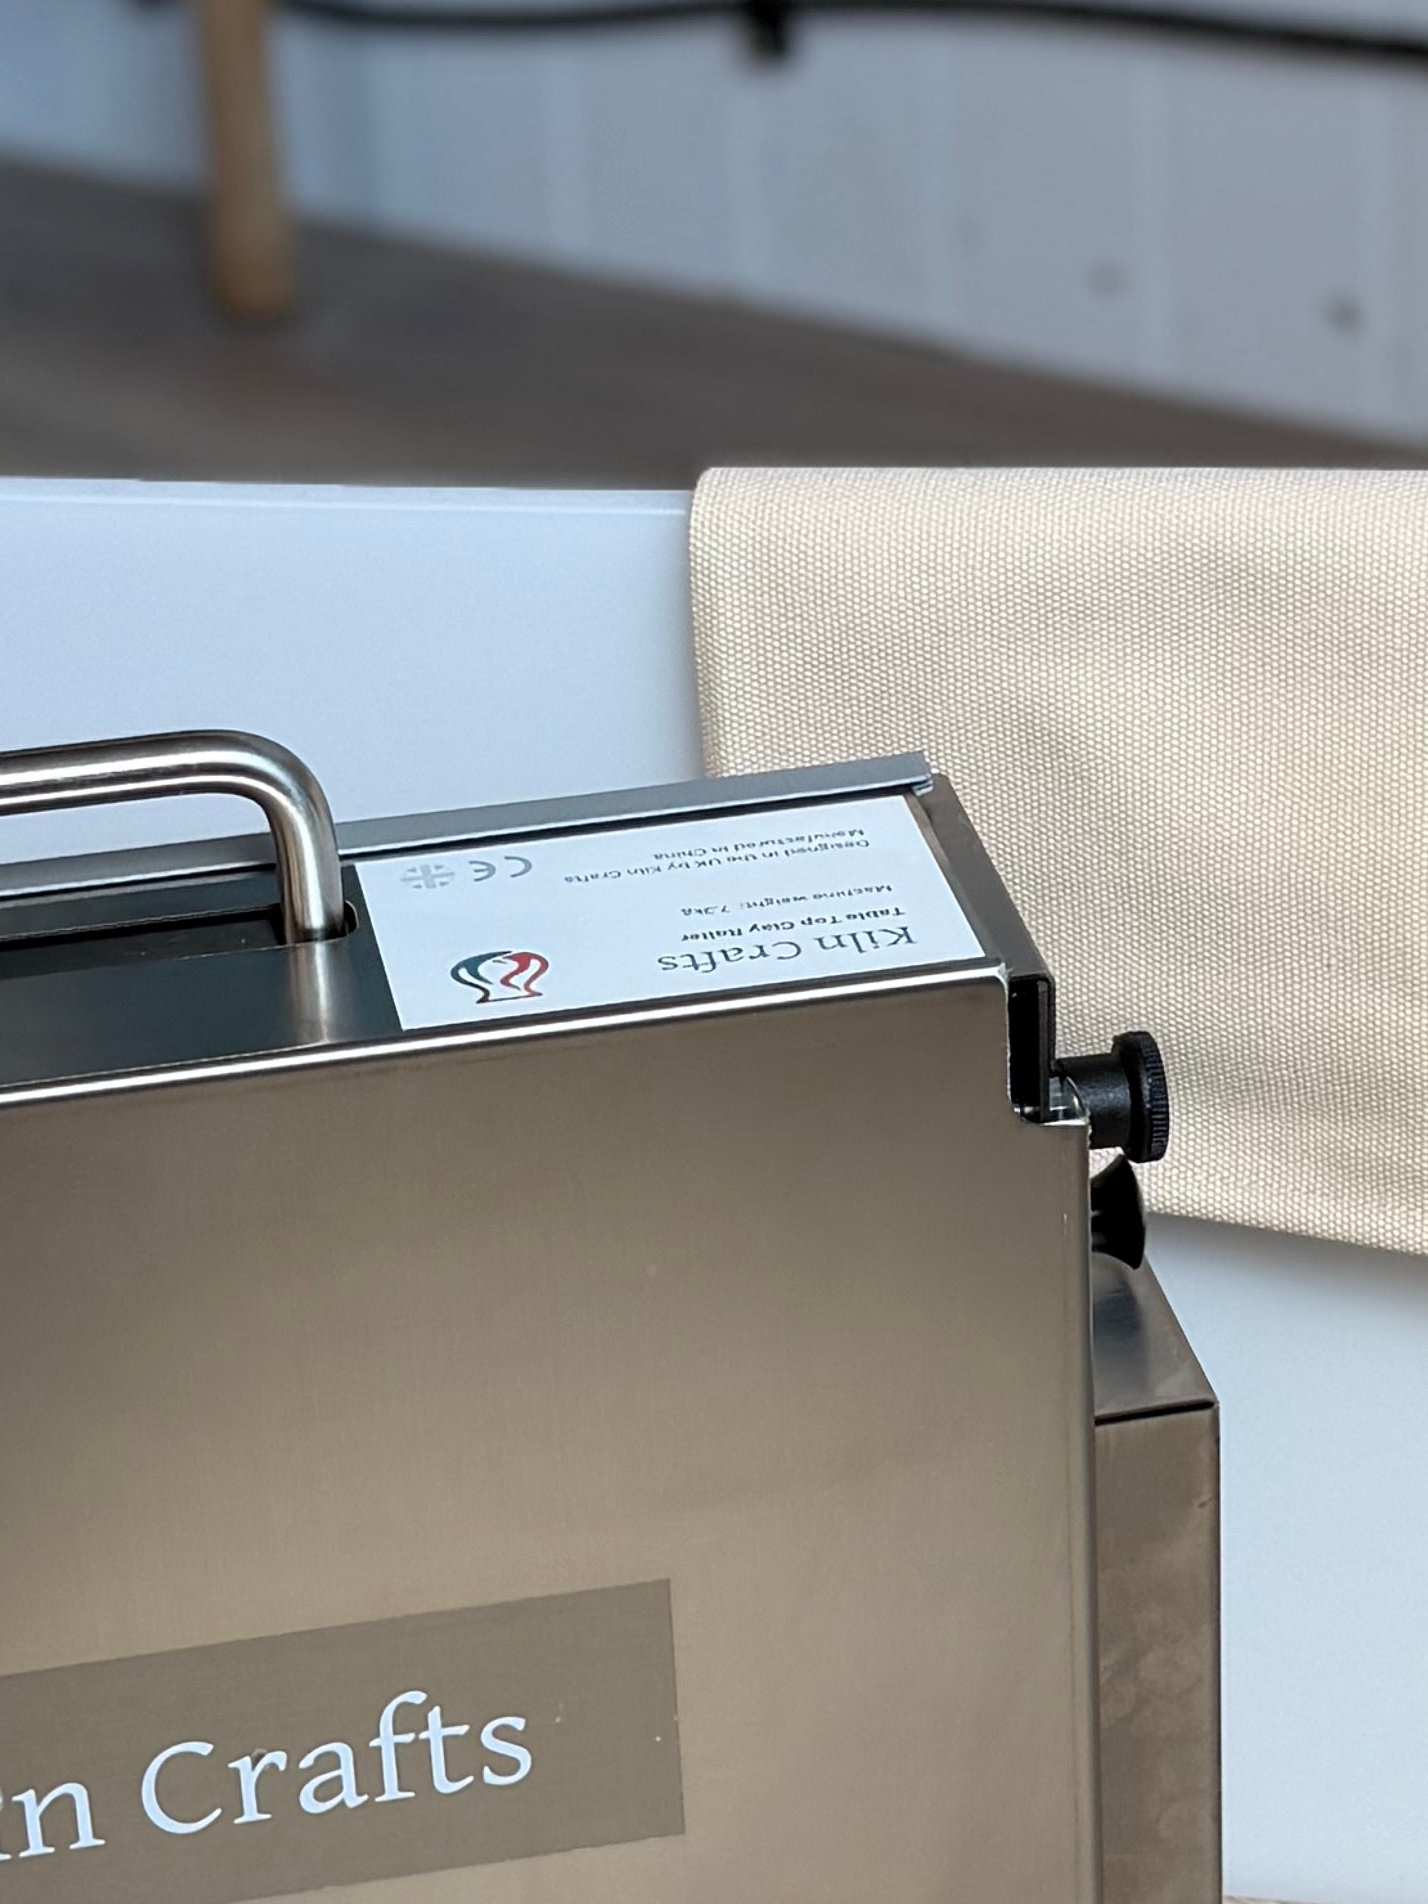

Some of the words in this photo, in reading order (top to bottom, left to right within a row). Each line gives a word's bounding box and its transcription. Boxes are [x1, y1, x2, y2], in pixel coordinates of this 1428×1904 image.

[654, 848, 707, 860] China
[694, 858, 722, 867] UK
[626, 866, 661, 875] Kiln
[800, 914, 840, 927] Top
[841, 906, 906, 922] Table
[749, 920, 795, 934] Clay
[681, 927, 743, 942] Roller
[813, 925, 917, 953] Kiln
[657, 941, 802, 973] Crafts
[139, 1689, 534, 1835] Crafts
